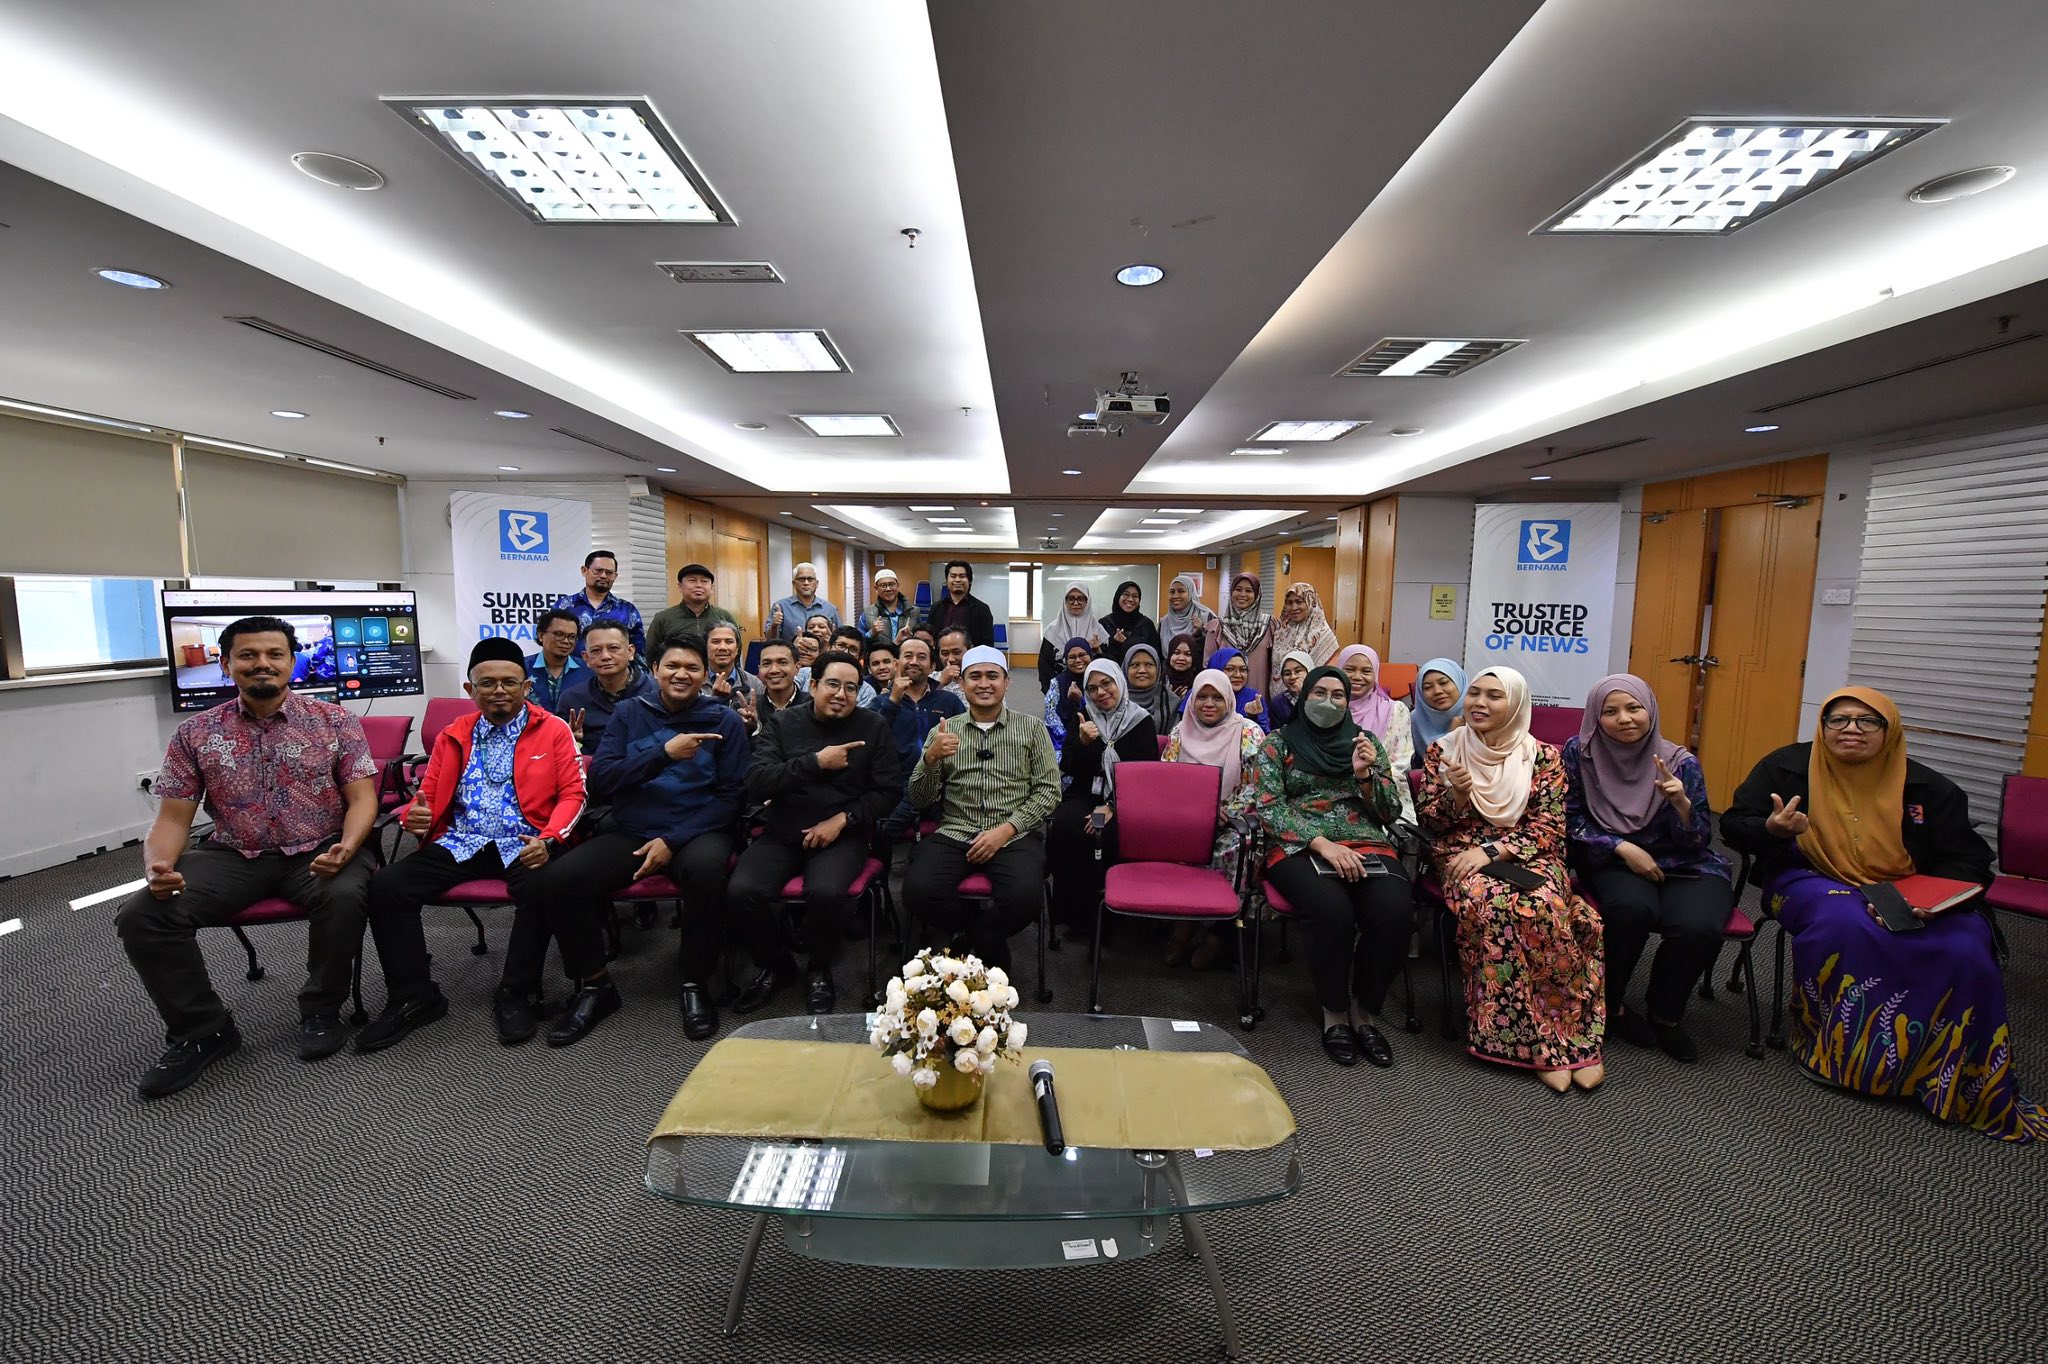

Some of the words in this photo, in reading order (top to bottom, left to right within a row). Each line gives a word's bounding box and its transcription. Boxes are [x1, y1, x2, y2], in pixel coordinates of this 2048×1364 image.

[500, 553, 549, 562] BERNAMA
[1491, 602, 1588, 621] TRUSTED
[479, 624, 538, 641] DIYA
[1492, 618, 1584, 637] SOURCE
[1484, 634, 1515, 651] OF
[1520, 635, 1589, 654] NEWS
